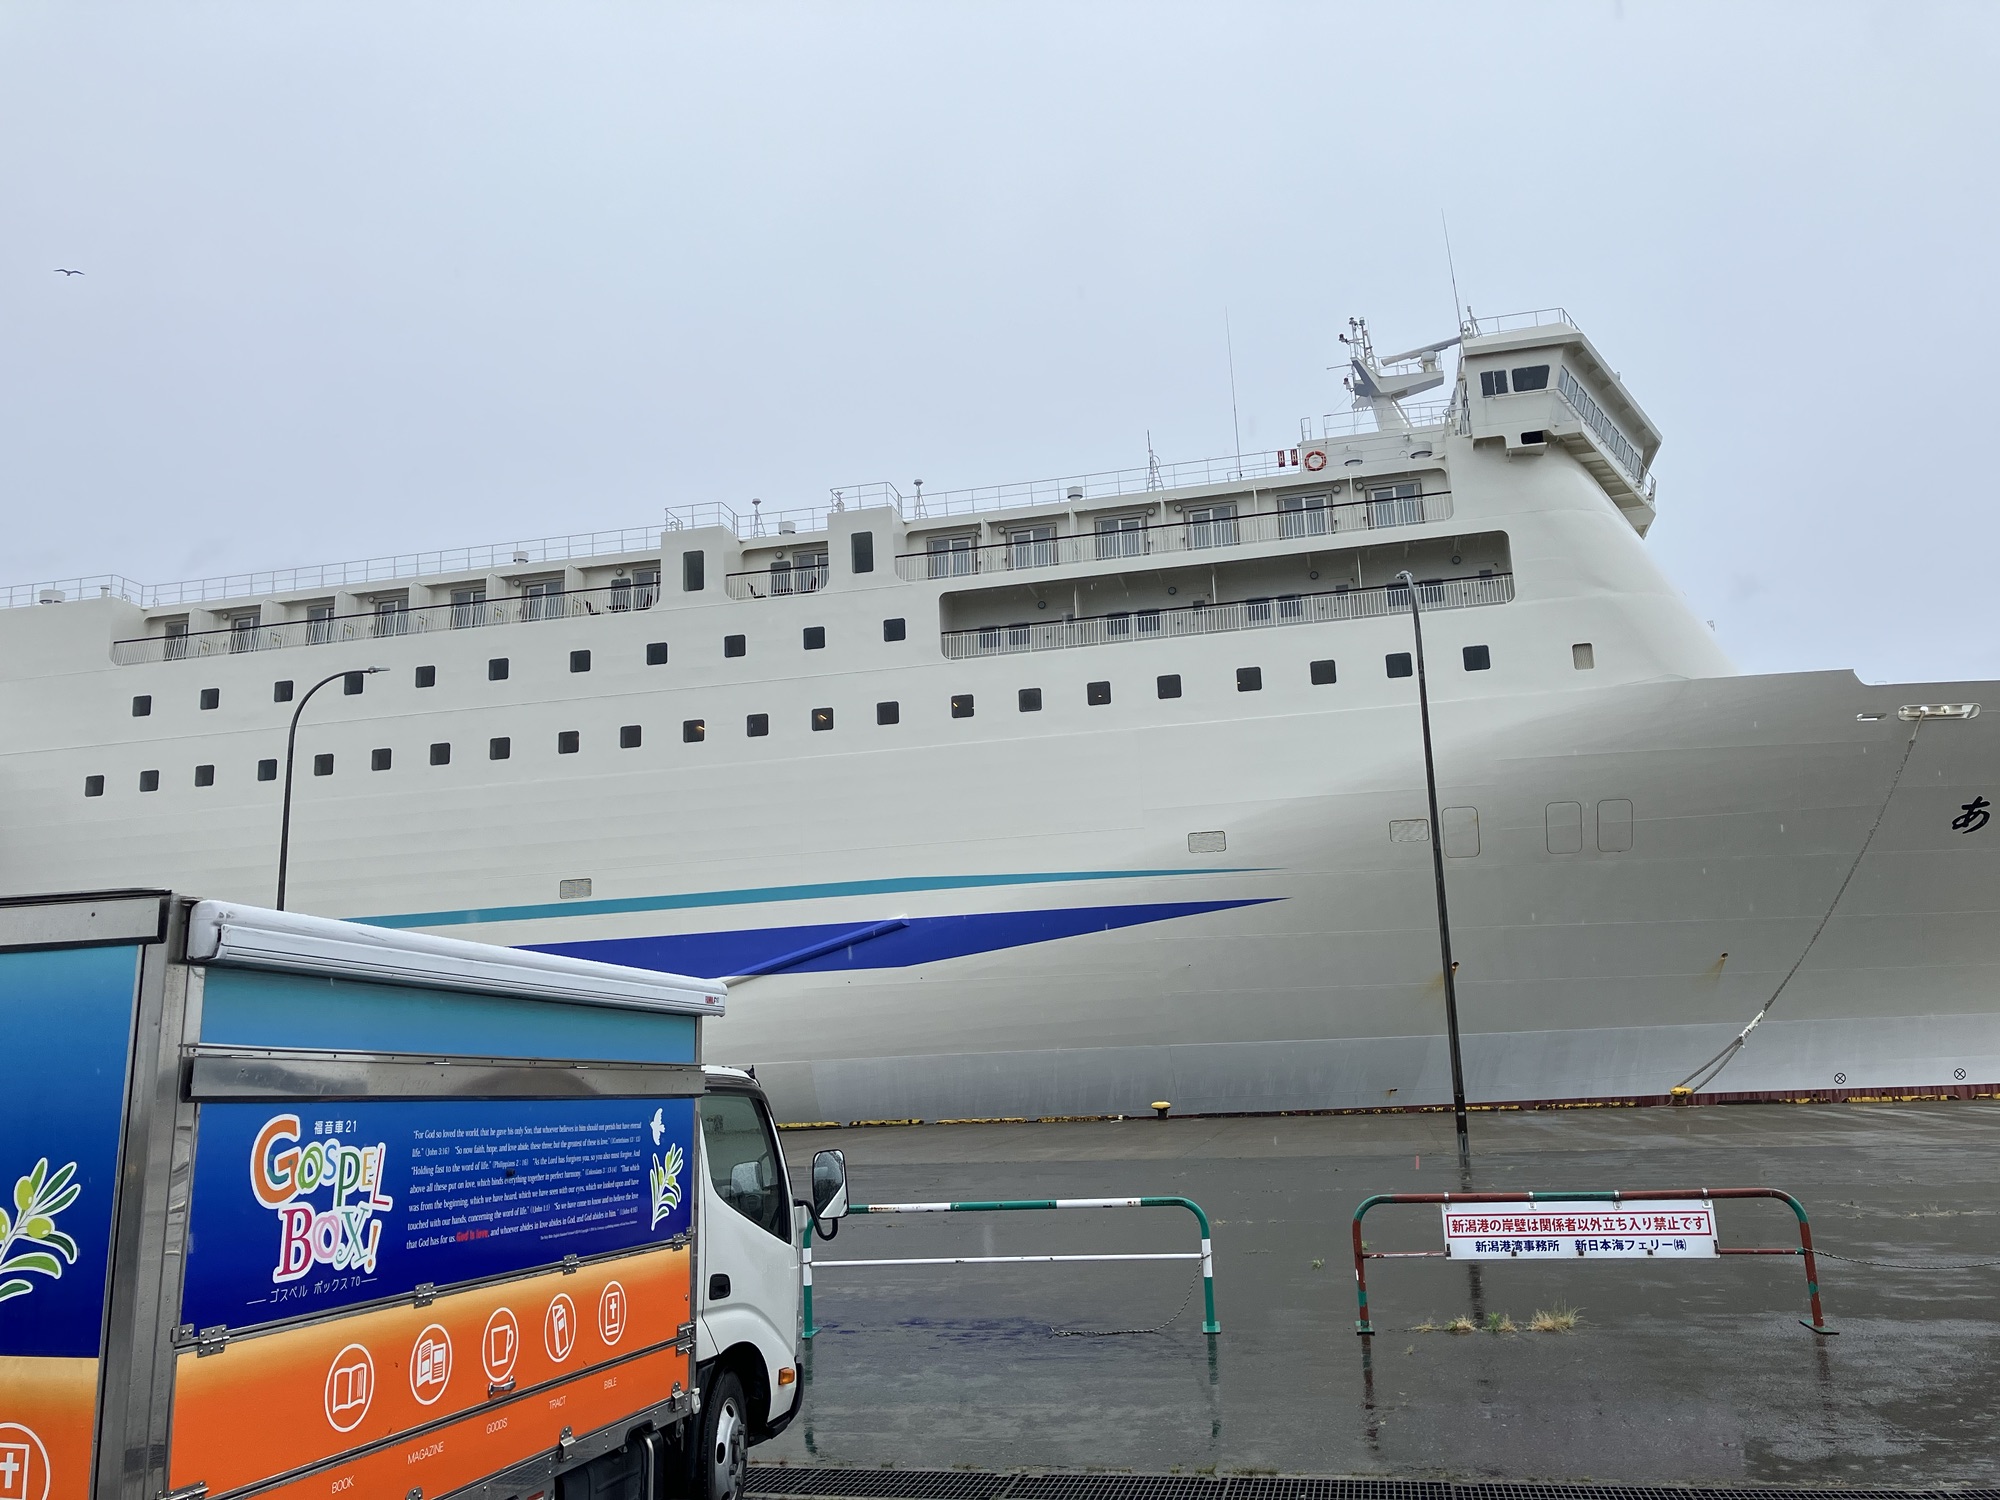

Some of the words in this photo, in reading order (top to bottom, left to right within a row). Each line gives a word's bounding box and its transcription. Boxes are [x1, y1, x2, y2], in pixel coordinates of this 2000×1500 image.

[1952, 796, 1991, 834] あ
[425, 1130, 435, 1139] God
[443, 1129, 456, 1138] loved
[480, 1128, 489, 1136] that
[490, 1128, 496, 1136] he
[496, 1130, 507, 1138] gave
[514, 1127, 524, 1137] only
[533, 1126, 542, 1134] that
[542, 1125, 559, 1133] whoever
[559, 1125, 574, 1133] believes
[425, 1148, 438, 1157] (John
[499, 1144, 507, 1152] and
[508, 1143, 517, 1151] love
[530, 1142, 541, 1150] these
[252, 1117, 391, 1207] GOSPEL
[435, 1165, 445, 1174] fast
[445, 1164, 452, 1173] to
[452, 1163, 460, 1172] the
[461, 1162, 474, 1171] word
[475, 1162, 480, 1170] of
[548, 1156, 557, 1164] Lord
[410, 1184, 426, 1194] above
[434, 1182, 448, 1191] these
[448, 1181, 457, 1193] put
[477, 1178, 491, 1187] which
[491, 1177, 504, 1186] binds
[504, 1174, 527, 1187] everything
[527, 1173, 545, 1184] together
[545, 1172, 549, 1180] in
[550, 1171, 564, 1182] perfect
[420, 1201, 434, 1211] from
[434, 1200, 443, 1209] the
[470, 1195, 484, 1205] which
[492, 1193, 503, 1202] have
[518, 1190, 531, 1199] which
[539, 1188, 548, 1197] have
[559, 1186, 567, 1194] with
[408, 1219, 429, 1231] touched
[430, 1217, 441, 1228] with
[468, 1211, 494, 1225] concerning
[494, 1210, 502, 1219] the
[502, 1208, 514, 1218] word
[514, 1208, 519, 1216] of
[567, 1200, 576, 1209] have
[1451, 1216, 1706, 1234] 新潟港の岸壁は関係者以外立ち入り禁止です
[406, 1239, 418, 1250] that
[418, 1237, 429, 1248] God
[430, 1235, 440, 1246] has
[440, 1234, 448, 1244] for
[456, 1231, 469, 1242] God
[470, 1230, 475, 1240] is
[490, 1227, 500, 1236] and
[500, 1224, 519, 1235] whoever
[520, 1222, 534, 1232] abides
[534, 1221, 539, 1229] in
[539, 1219, 548, 1228] love
[549, 1217, 562, 1227] abides
[562, 1217, 567, 1225] in
[1475, 1239, 1560, 1253] 新潟港湾事務所
[270, 1285, 308, 1304] ゴスペル
[604, 1376, 617, 1389] BIBLE
[549, 1395, 567, 1410] TRACT
[486, 1417, 508, 1435] GOODS
[407, 1441, 444, 1464] MAGAZINE
[331, 1475, 354, 1494] BOOK
